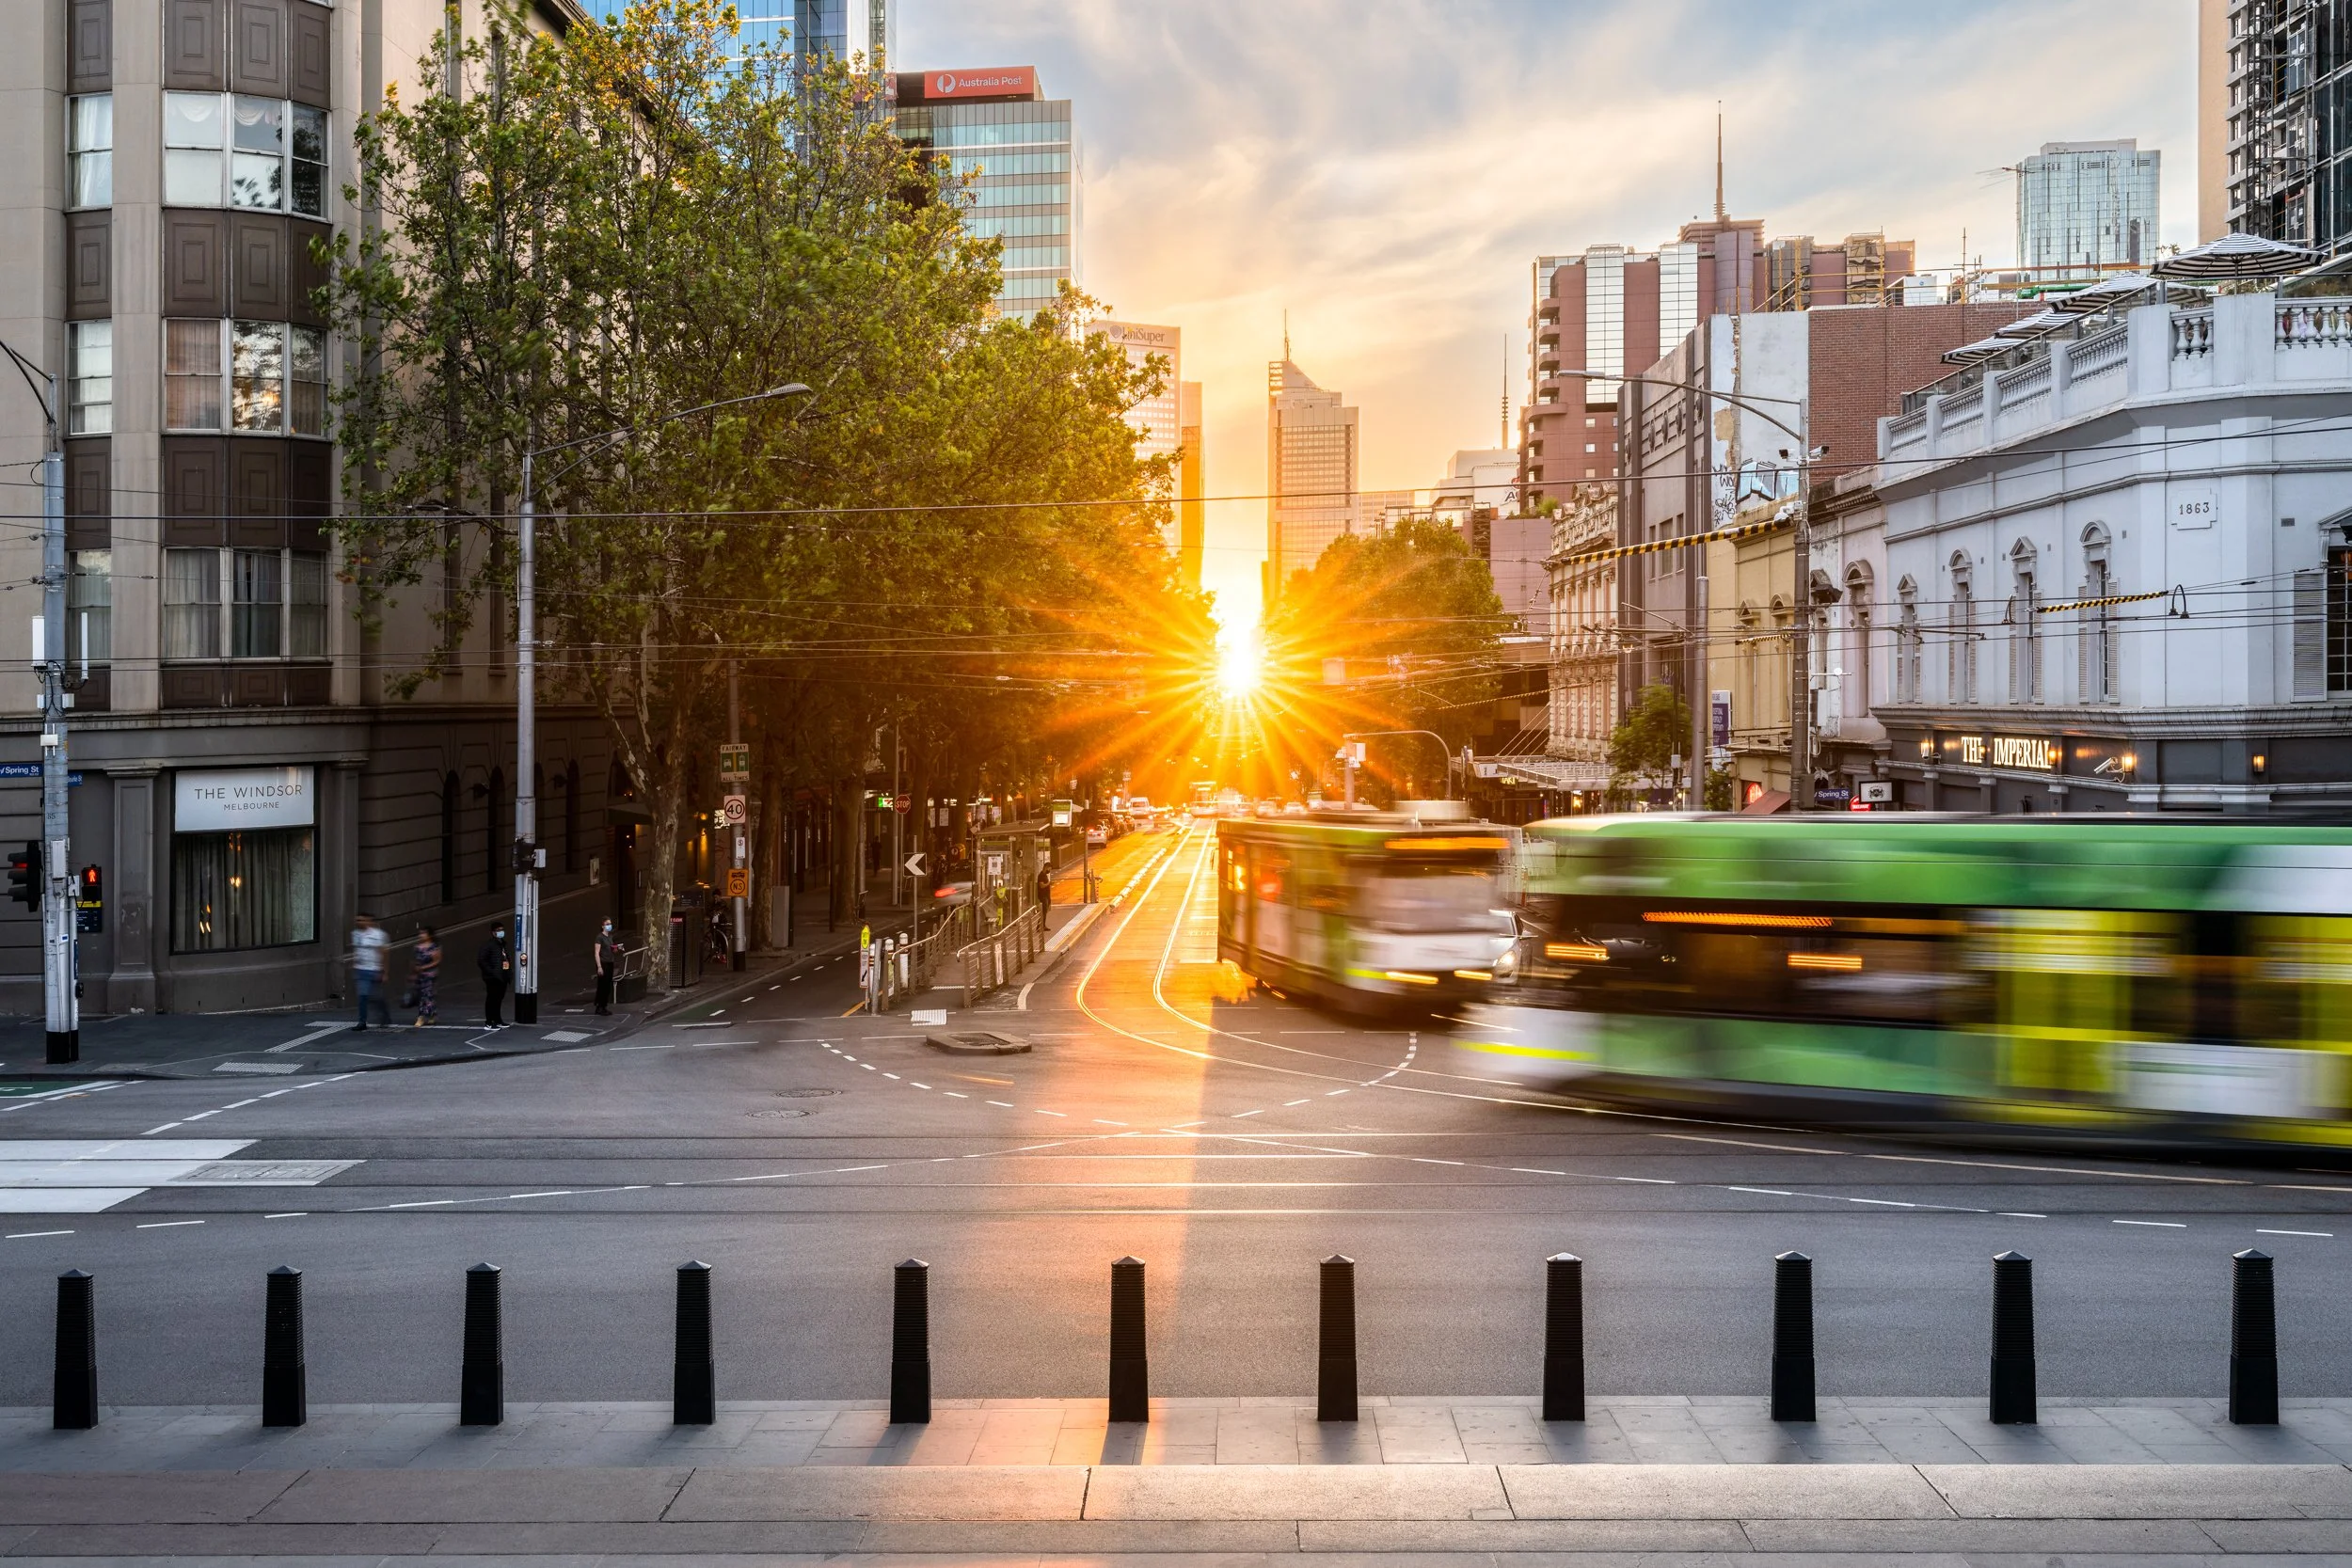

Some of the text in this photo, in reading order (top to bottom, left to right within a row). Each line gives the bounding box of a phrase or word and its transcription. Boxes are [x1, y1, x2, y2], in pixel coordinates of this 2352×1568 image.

[959, 75, 1023, 87] Australia Post
[2179, 501, 2210, 515] 1863
[1993, 738, 2052, 768] IMPERIAL
[5, 766, 29, 775] Spring
[30, 765, 40, 773] St
[195, 784, 302, 800] THE WINDSOR
[1818, 791, 1840, 800] Spring
[224, 801, 279, 811] MELBOURNE
[726, 803, 742, 815] 40
[733, 882, 743, 891] NS
